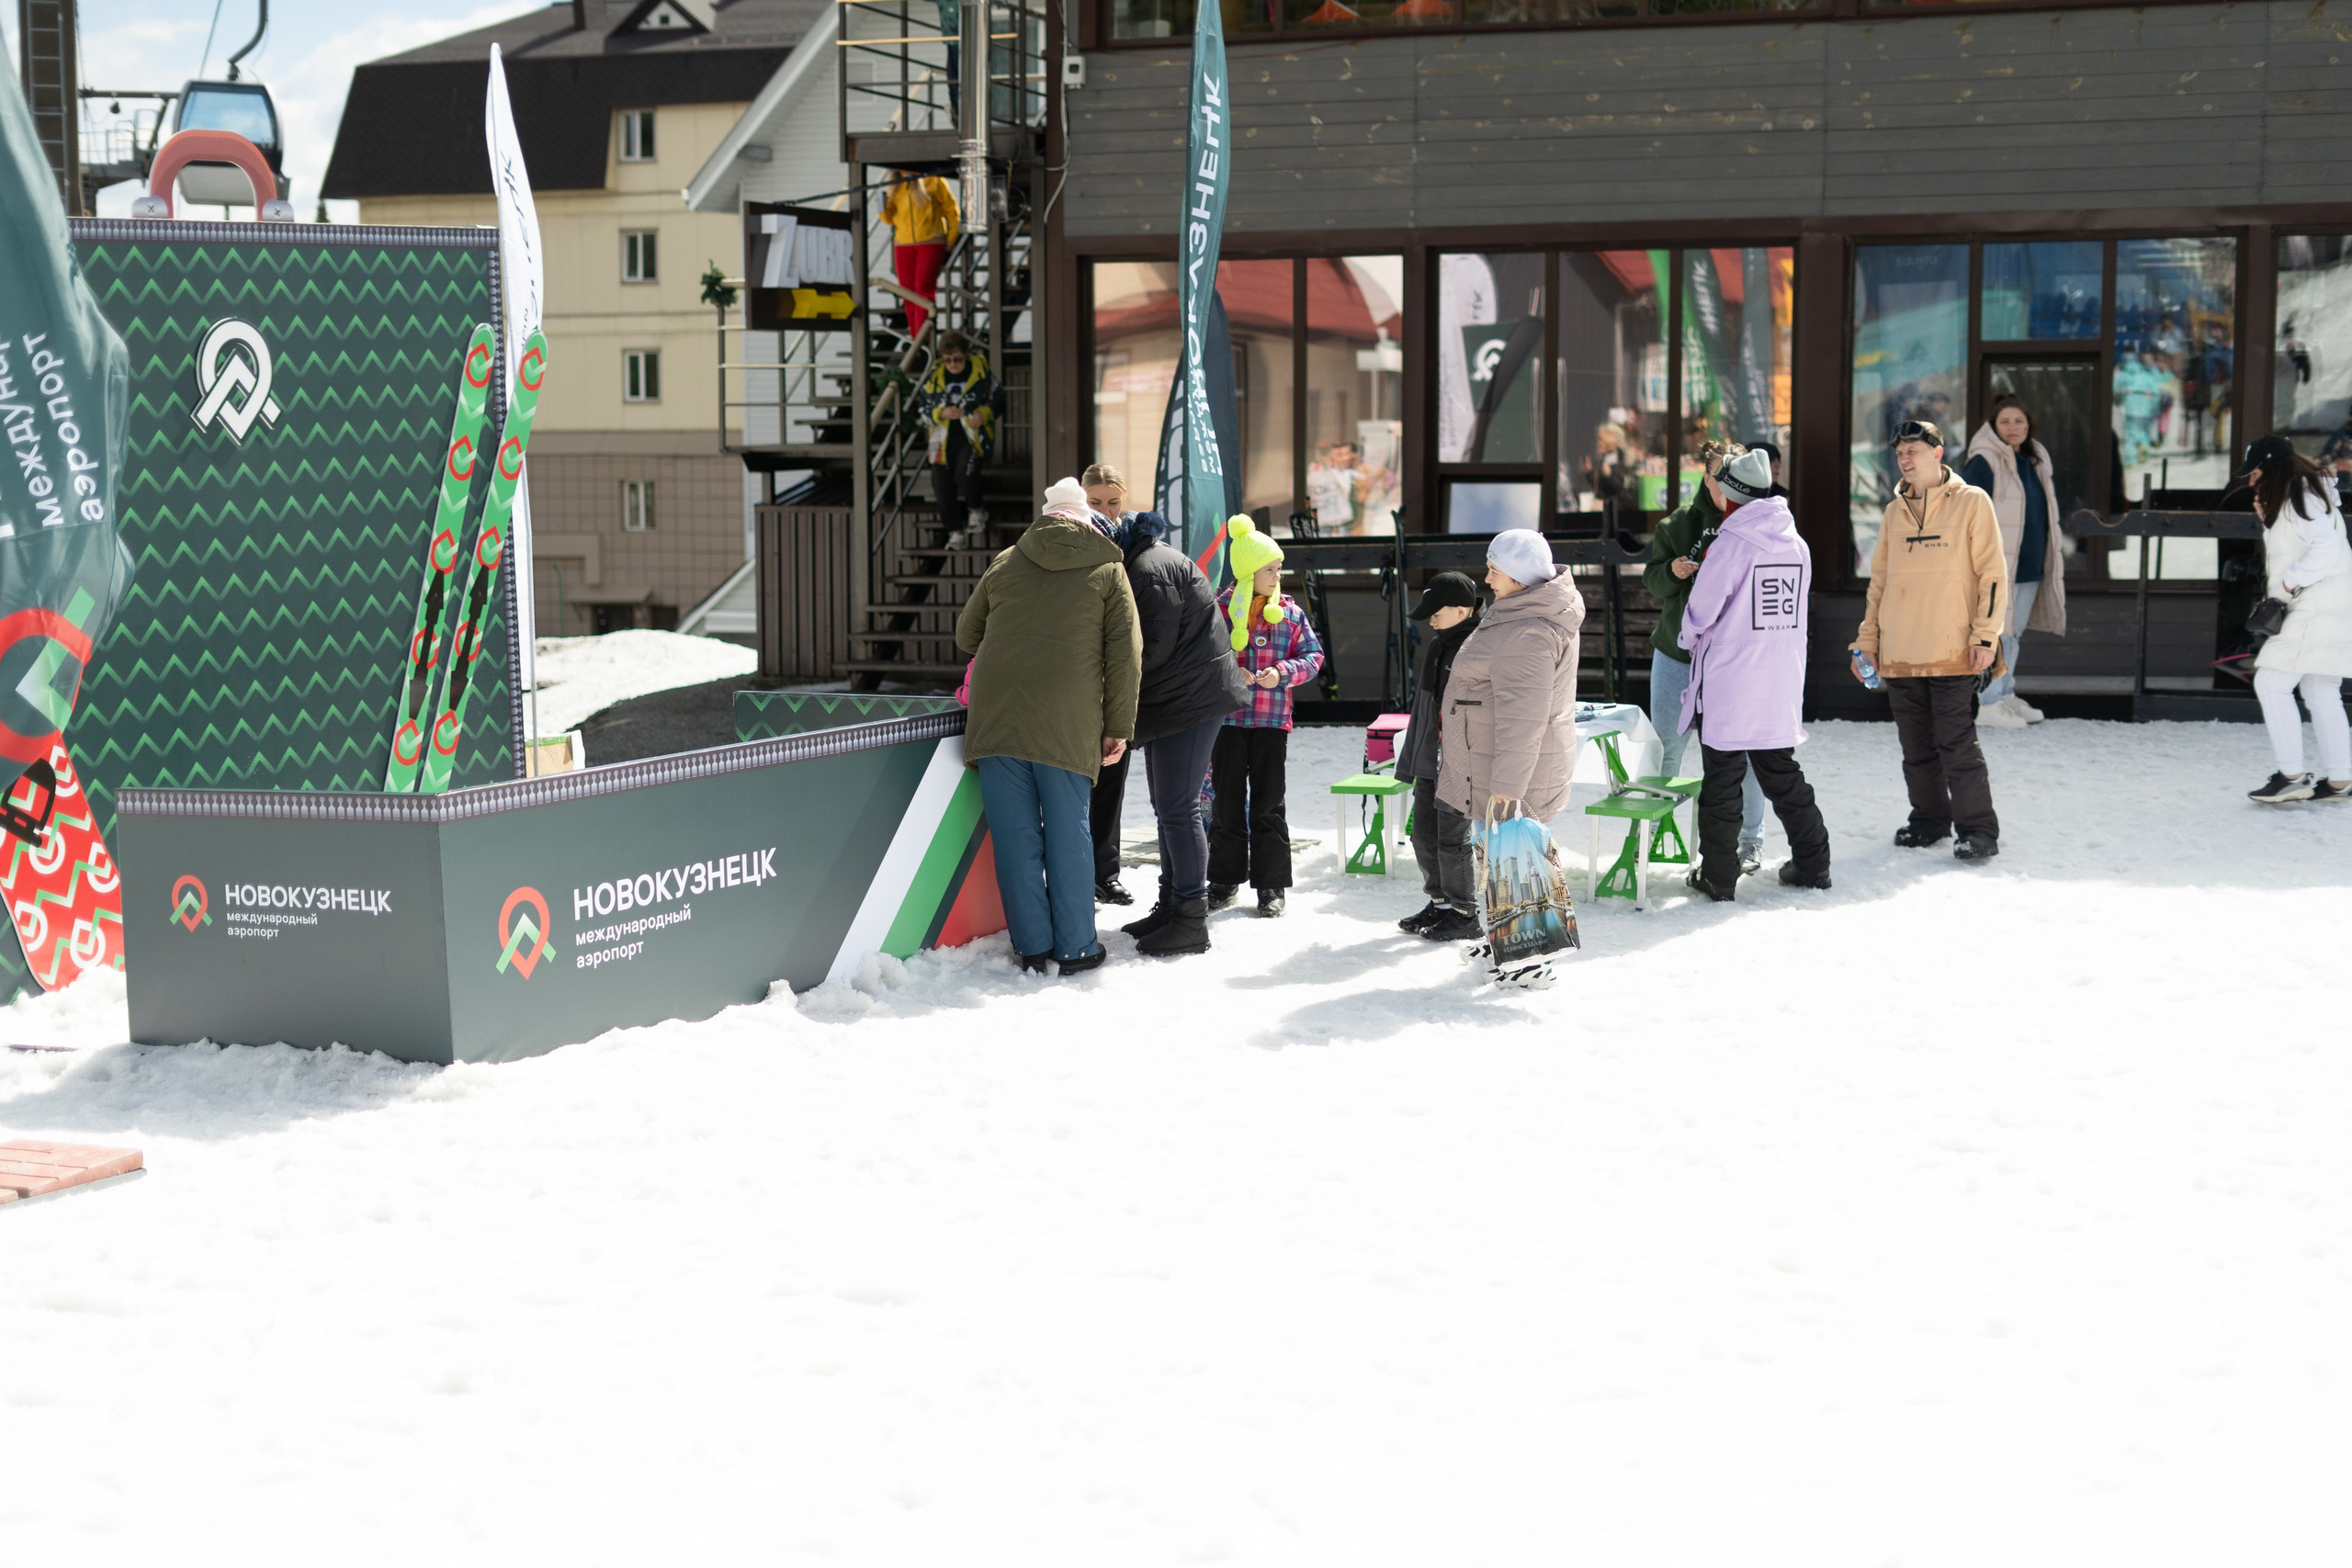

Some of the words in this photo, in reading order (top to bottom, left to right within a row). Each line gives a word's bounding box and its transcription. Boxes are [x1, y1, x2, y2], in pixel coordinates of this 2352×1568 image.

[761, 214, 855, 288] ZUBR
[22, 333, 105, 521] аэропорт
[224, 884, 392, 916] НОВОКУЗНЕЦК
[573, 847, 778, 921] НОВОКУЗНЕЦК
[226, 912, 318, 926] международный
[227, 926, 279, 940] аэропорт
[575, 903, 692, 946] международный
[1500, 927, 1546, 946] TOWN
[576, 941, 644, 969] аэропорт
